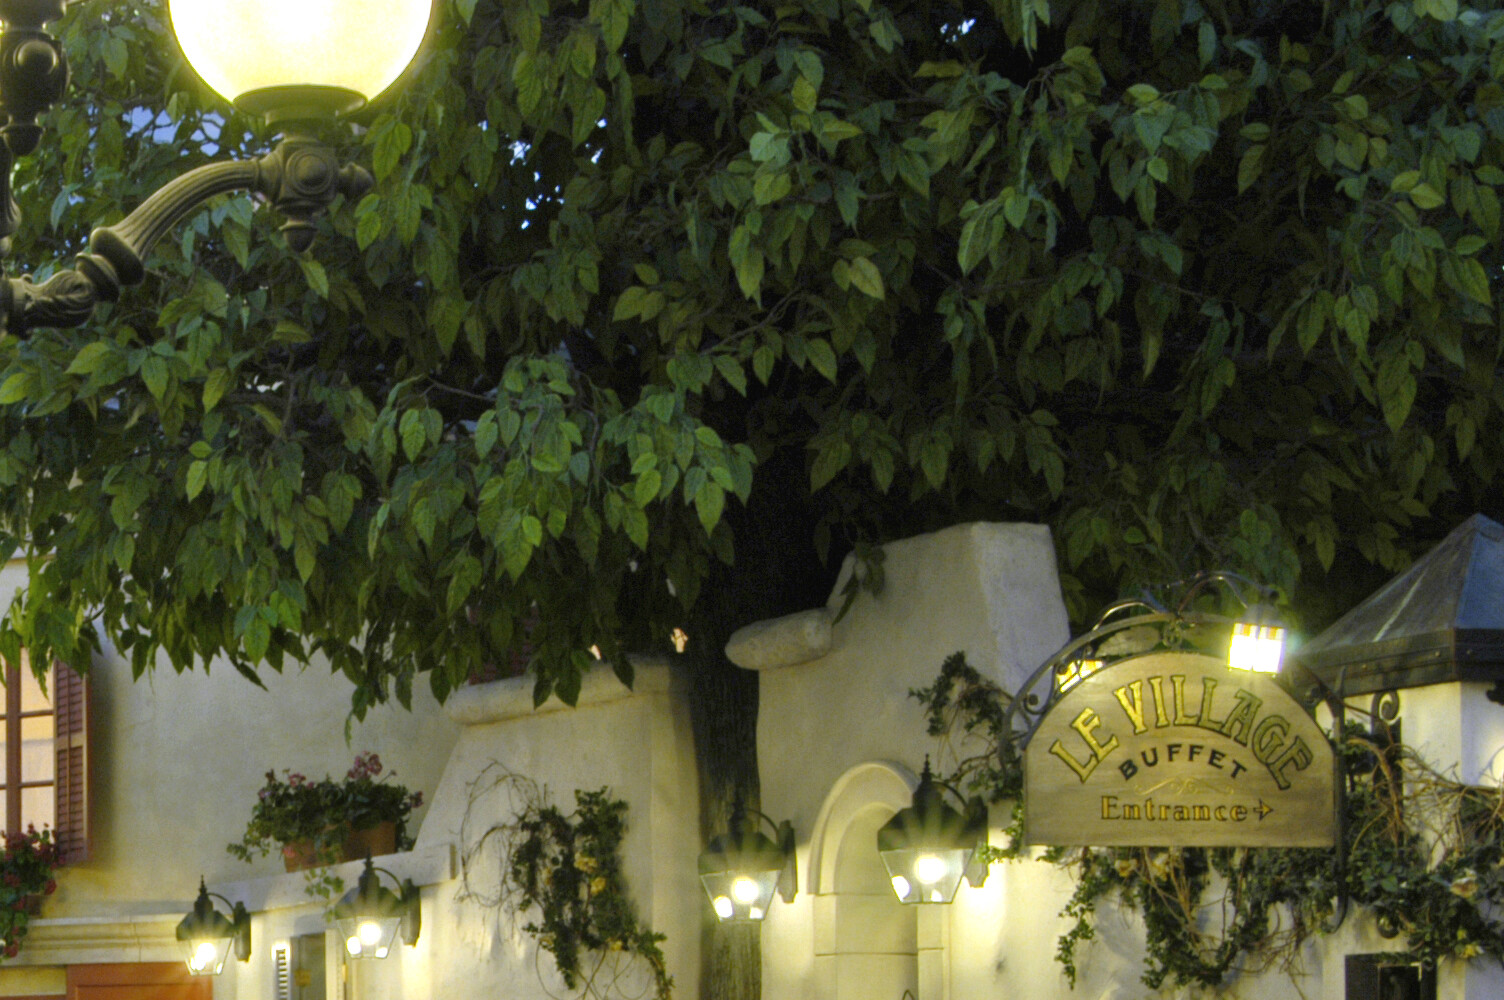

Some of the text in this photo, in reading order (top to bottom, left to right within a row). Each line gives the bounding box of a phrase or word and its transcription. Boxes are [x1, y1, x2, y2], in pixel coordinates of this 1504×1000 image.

[1049, 674, 1314, 790] LE VILLAGE
[1118, 744, 1248, 780] BUFFET
[1100, 795, 1248, 822] Entrance
